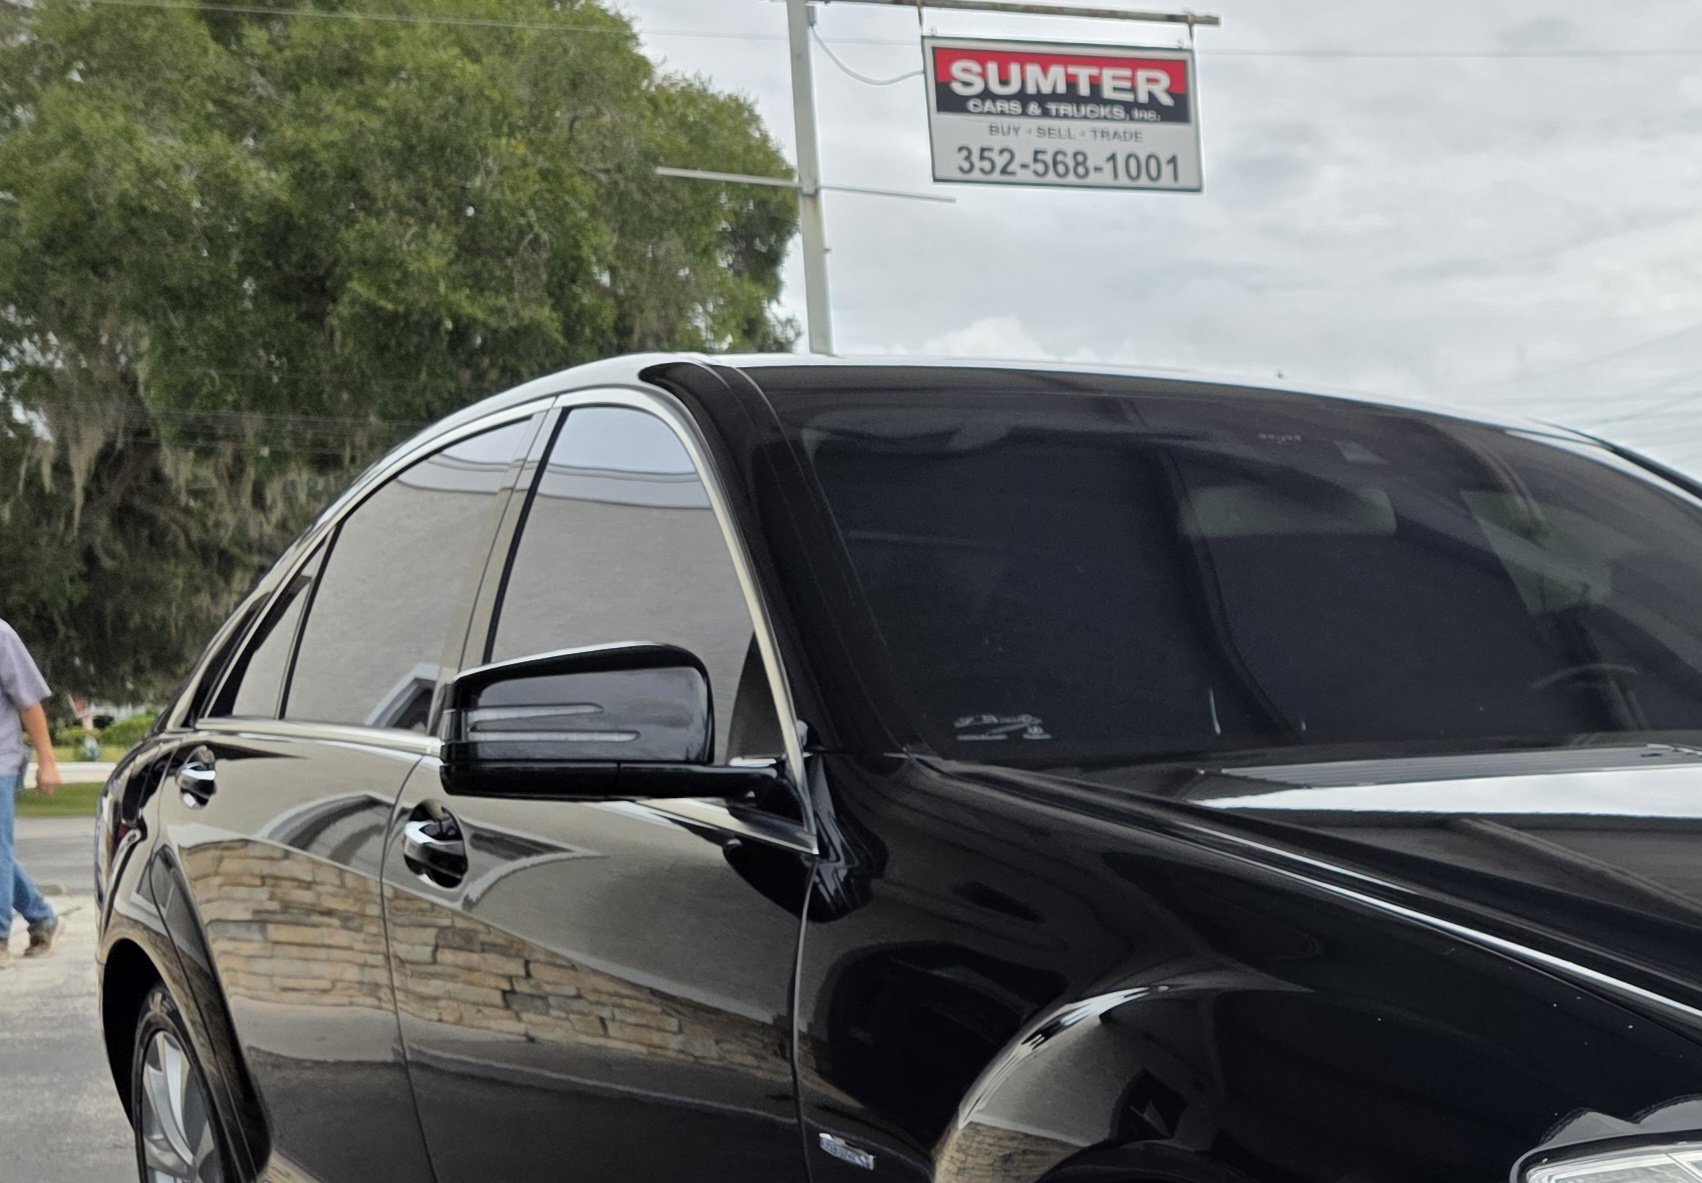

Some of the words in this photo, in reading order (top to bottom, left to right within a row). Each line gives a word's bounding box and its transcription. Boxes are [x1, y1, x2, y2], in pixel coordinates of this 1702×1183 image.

[949, 59, 1175, 107] SUMTER
[967, 98, 1023, 116] CARS
[1026, 101, 1042, 116] &
[989, 123, 1022, 137] BUY
[1036, 126, 1076, 140] SELL
[1090, 127, 1144, 143] TRADE
[956, 145, 1180, 183] 352-568-1001
